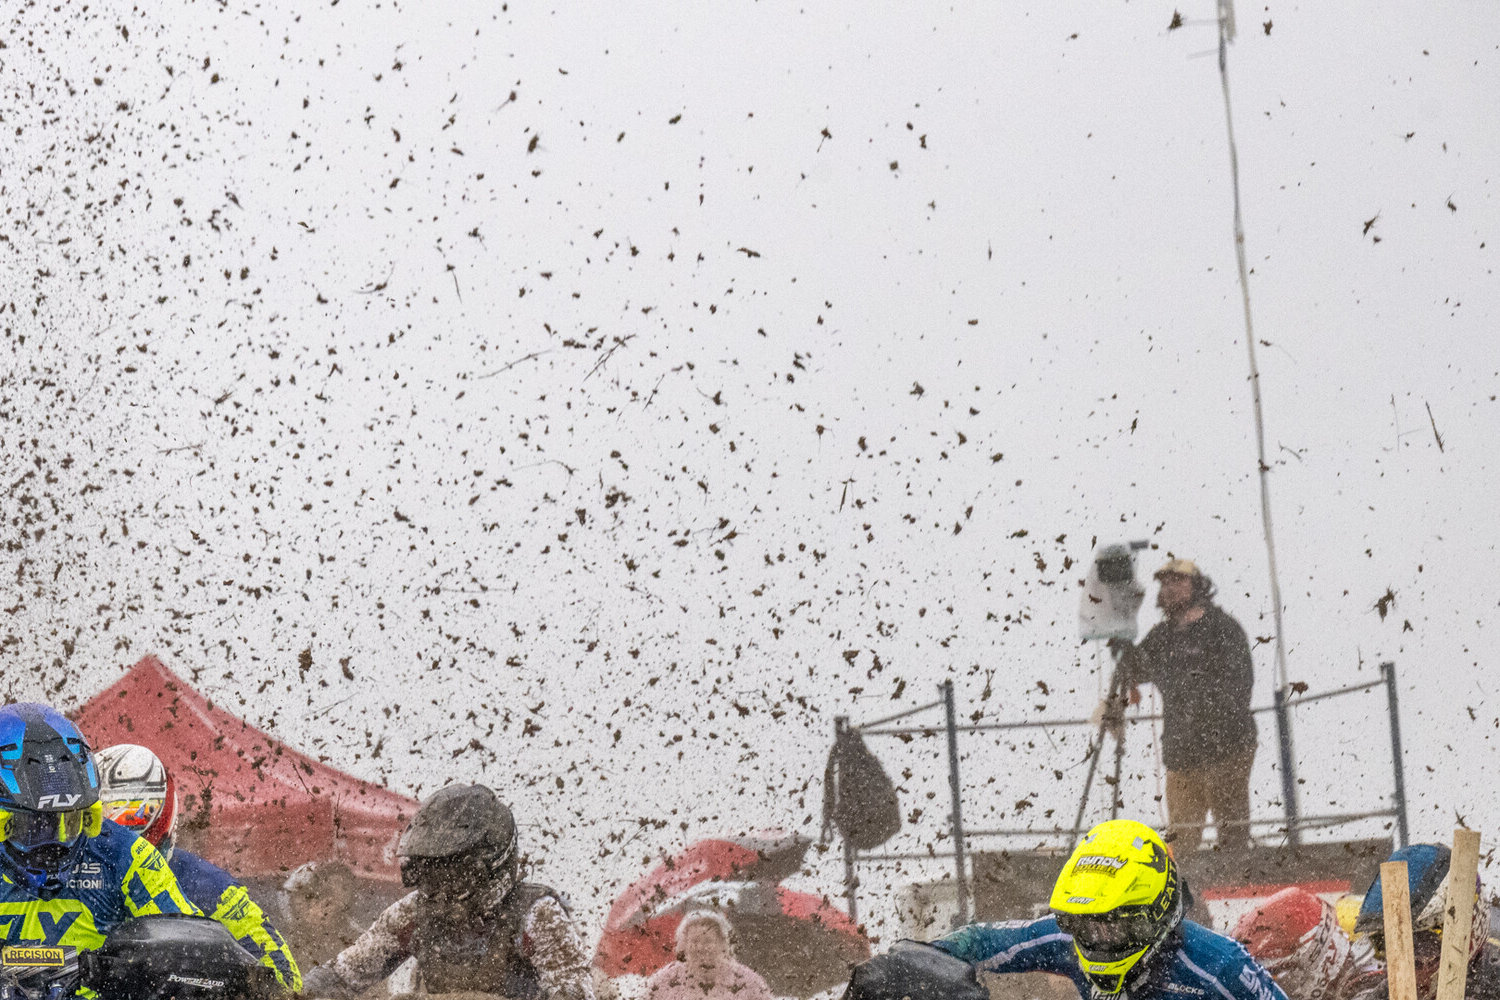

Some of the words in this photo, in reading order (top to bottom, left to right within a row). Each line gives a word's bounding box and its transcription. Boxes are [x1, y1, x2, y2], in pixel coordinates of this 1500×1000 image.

[37, 793, 81, 809] FLY
[1152, 861, 1177, 921] LEATT
[4, 949, 61, 960] RECISION
